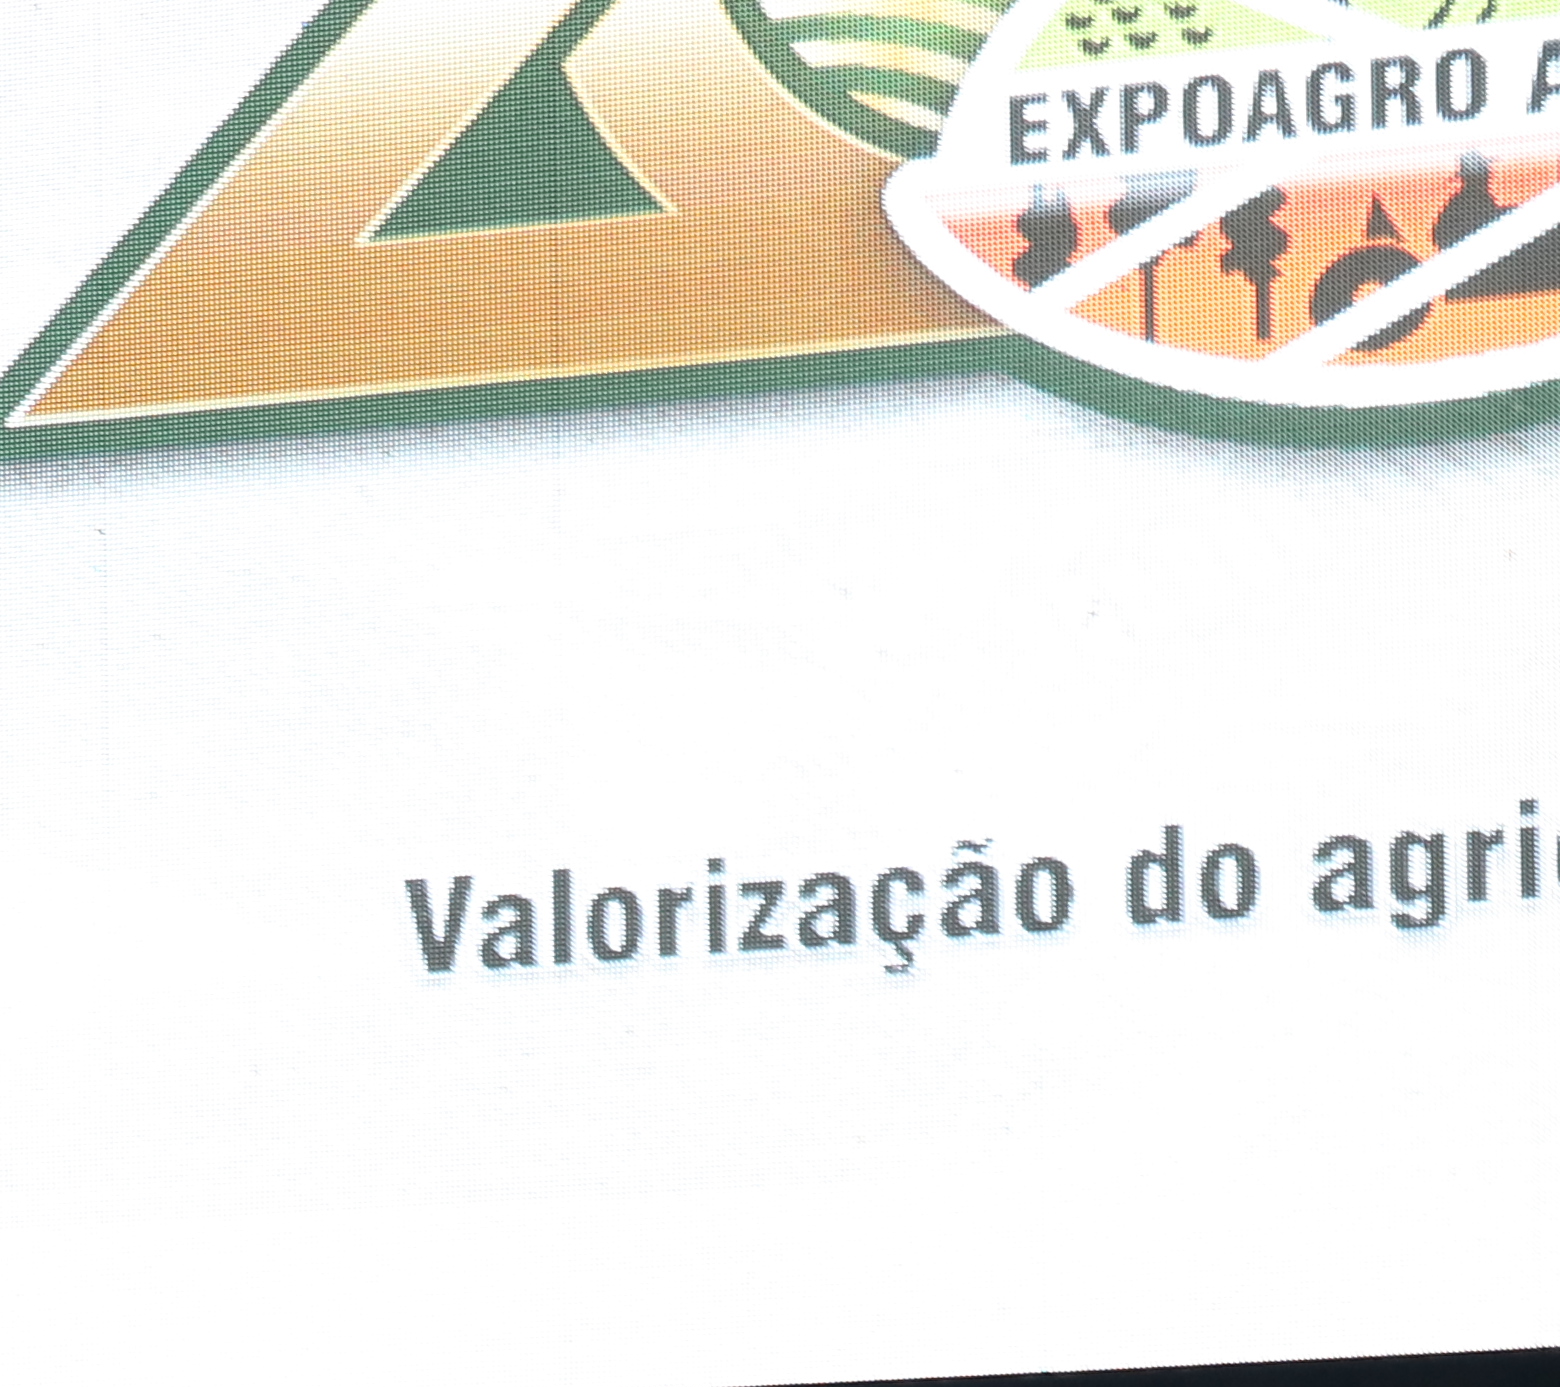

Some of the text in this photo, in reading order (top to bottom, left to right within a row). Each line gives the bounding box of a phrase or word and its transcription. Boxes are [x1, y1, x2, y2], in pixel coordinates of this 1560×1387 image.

[1009, 48, 1489, 166] EXPOAGRO
[406, 798, 1560, 974] Valorização do agri
